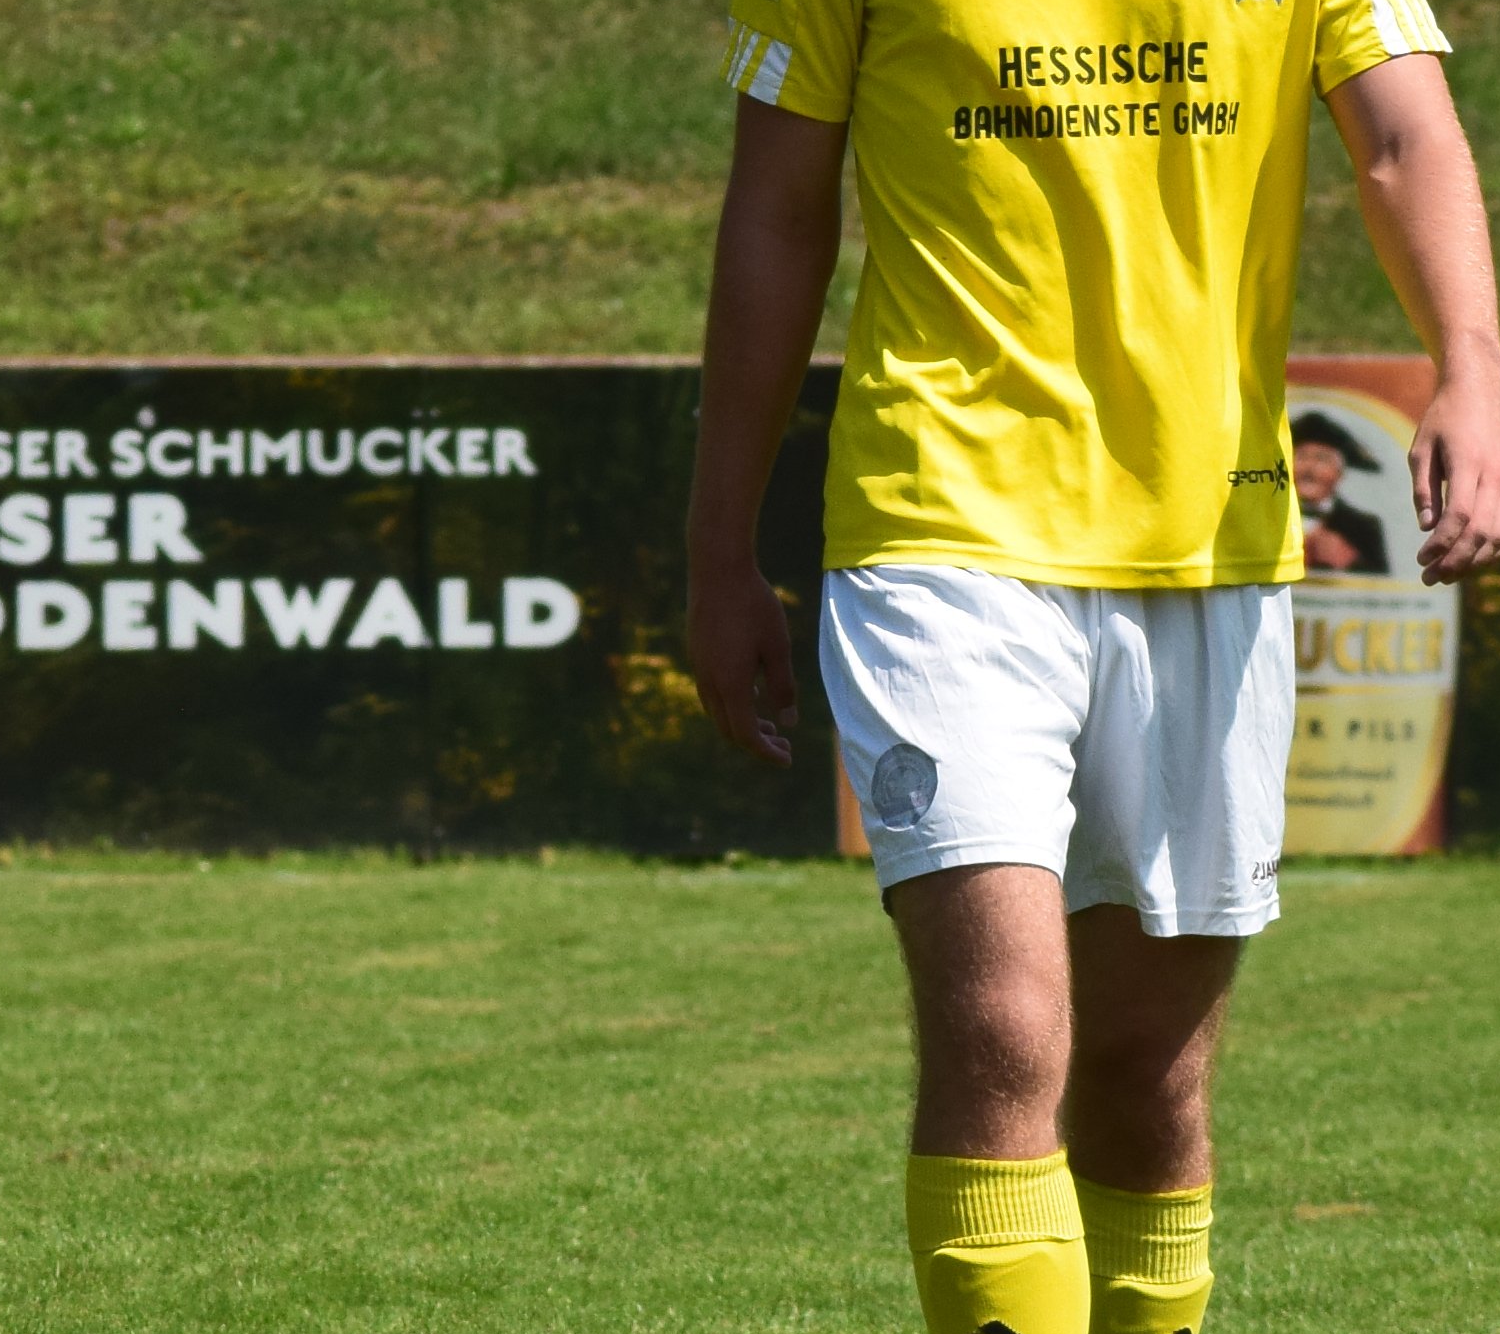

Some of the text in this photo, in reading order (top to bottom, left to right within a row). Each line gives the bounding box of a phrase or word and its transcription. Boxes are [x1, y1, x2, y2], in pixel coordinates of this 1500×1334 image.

[998, 41, 1209, 89] HESSISCHE
[954, 101, 1241, 140] BAHNDIENSTE GMBH
[109, 427, 539, 478] SCHMUCKER
